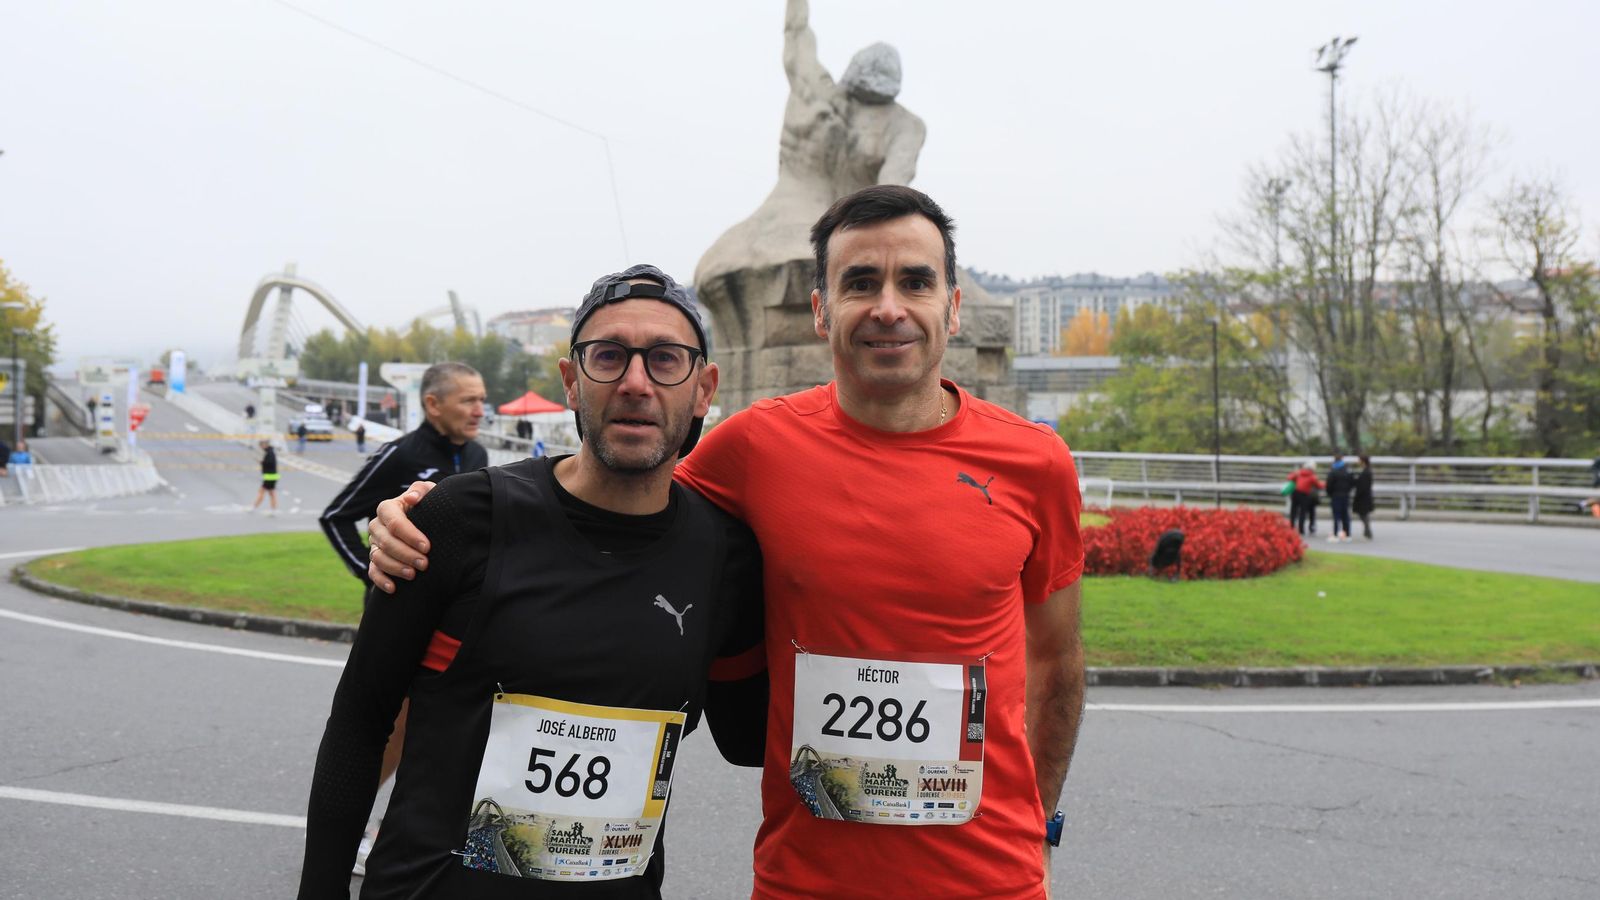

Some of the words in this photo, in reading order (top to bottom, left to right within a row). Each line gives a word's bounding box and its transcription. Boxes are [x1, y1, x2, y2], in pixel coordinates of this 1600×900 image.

[857, 666, 900, 684] HÉCTOR
[821, 693, 930, 744] 2286
[536, 718, 567, 737] JOSÉ
[568, 724, 616, 742] ALBERTO
[524, 747, 612, 800] 568
[865, 771, 884, 779] SAN
[921, 778, 967, 792] XLVIII
[864, 788, 908, 797] OURENSE
[551, 829, 571, 837] SAN
[604, 834, 643, 849] XLVIII
[548, 846, 591, 855] OURENSE
